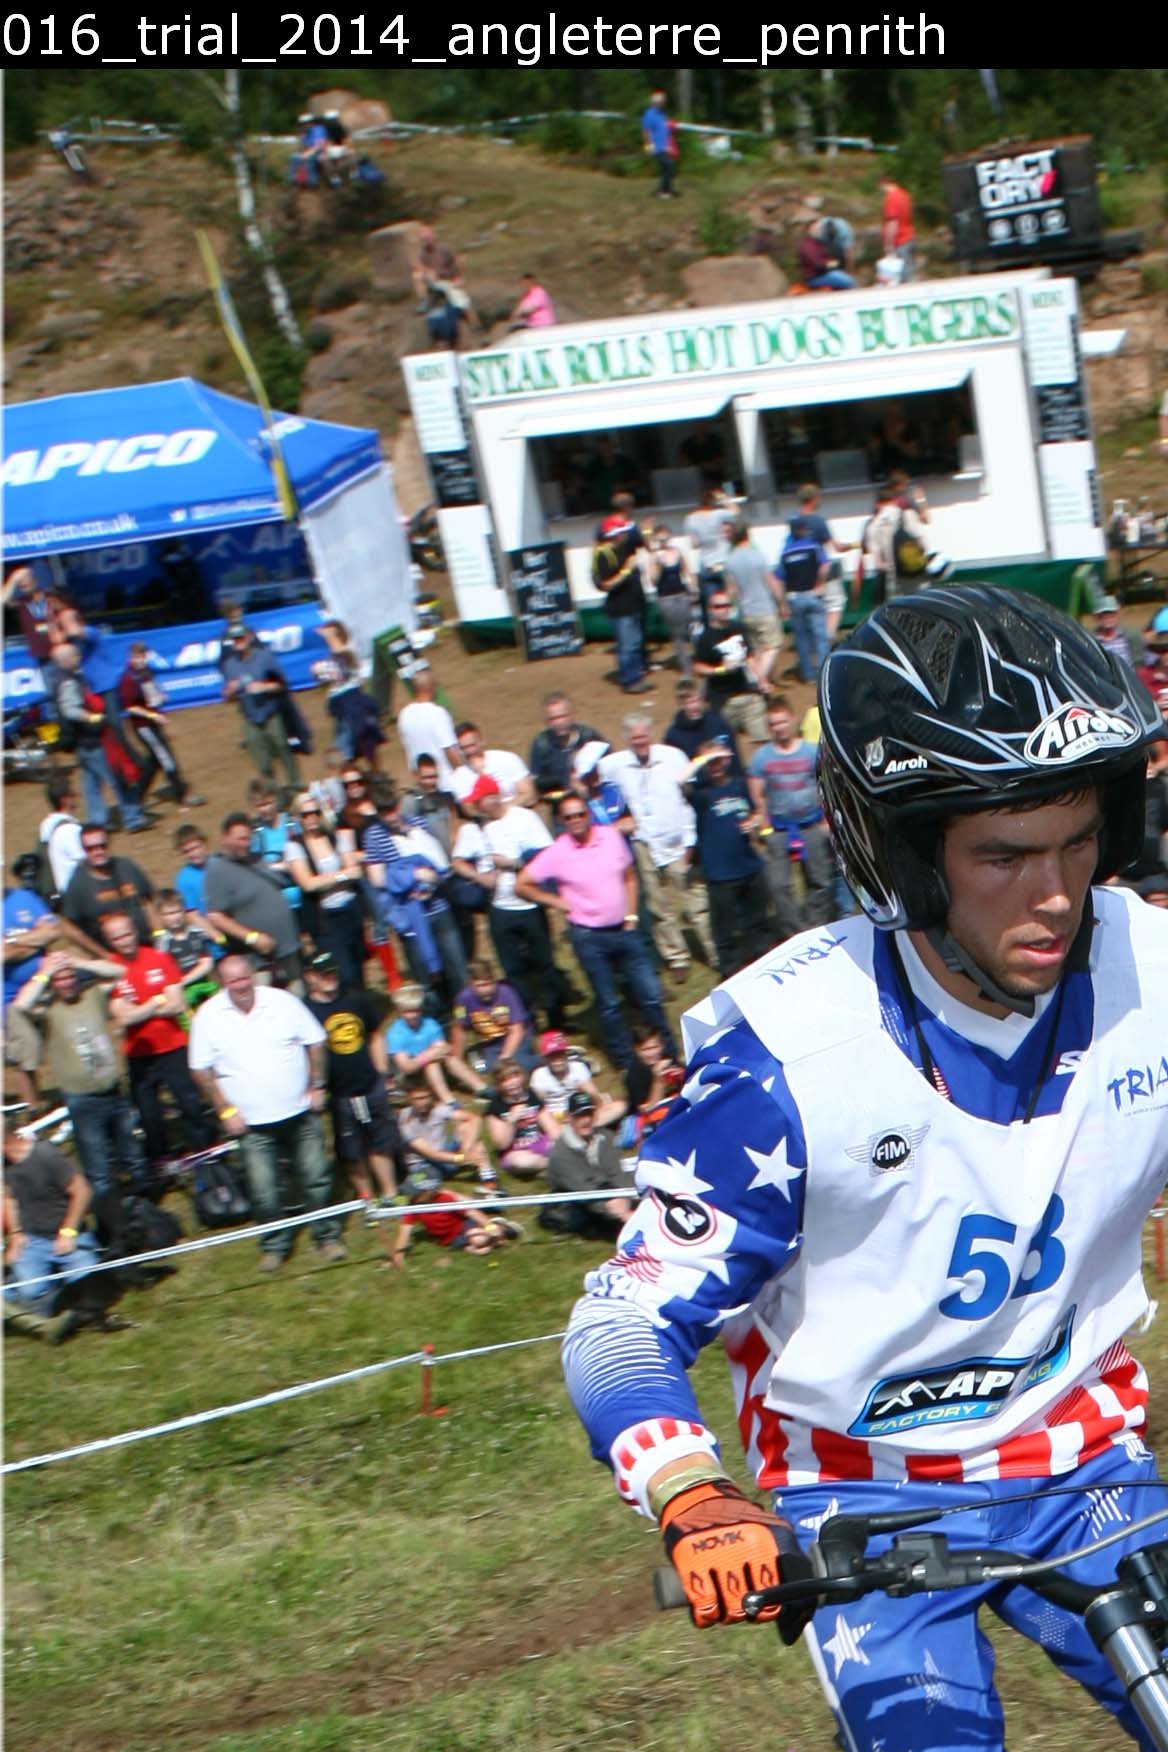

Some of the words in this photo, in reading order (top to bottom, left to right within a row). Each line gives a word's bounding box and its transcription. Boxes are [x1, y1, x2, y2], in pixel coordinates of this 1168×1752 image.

[977, 149, 1057, 187] FACT
[464, 350, 558, 397] STEAK
[563, 334, 655, 386] ROLLS
[665, 323, 734, 374] HOT
[748, 312, 846, 366] DOGS
[855, 294, 1016, 351] BURGERS
[3, 429, 219, 487] APICO
[1037, 709, 1135, 758] Airoh
[884, 755, 929, 775] Airoh
[754, 935, 849, 985] TRIAL
[876, 1141, 906, 1160] FIM
[869, 1403, 977, 1432] FACTORY
